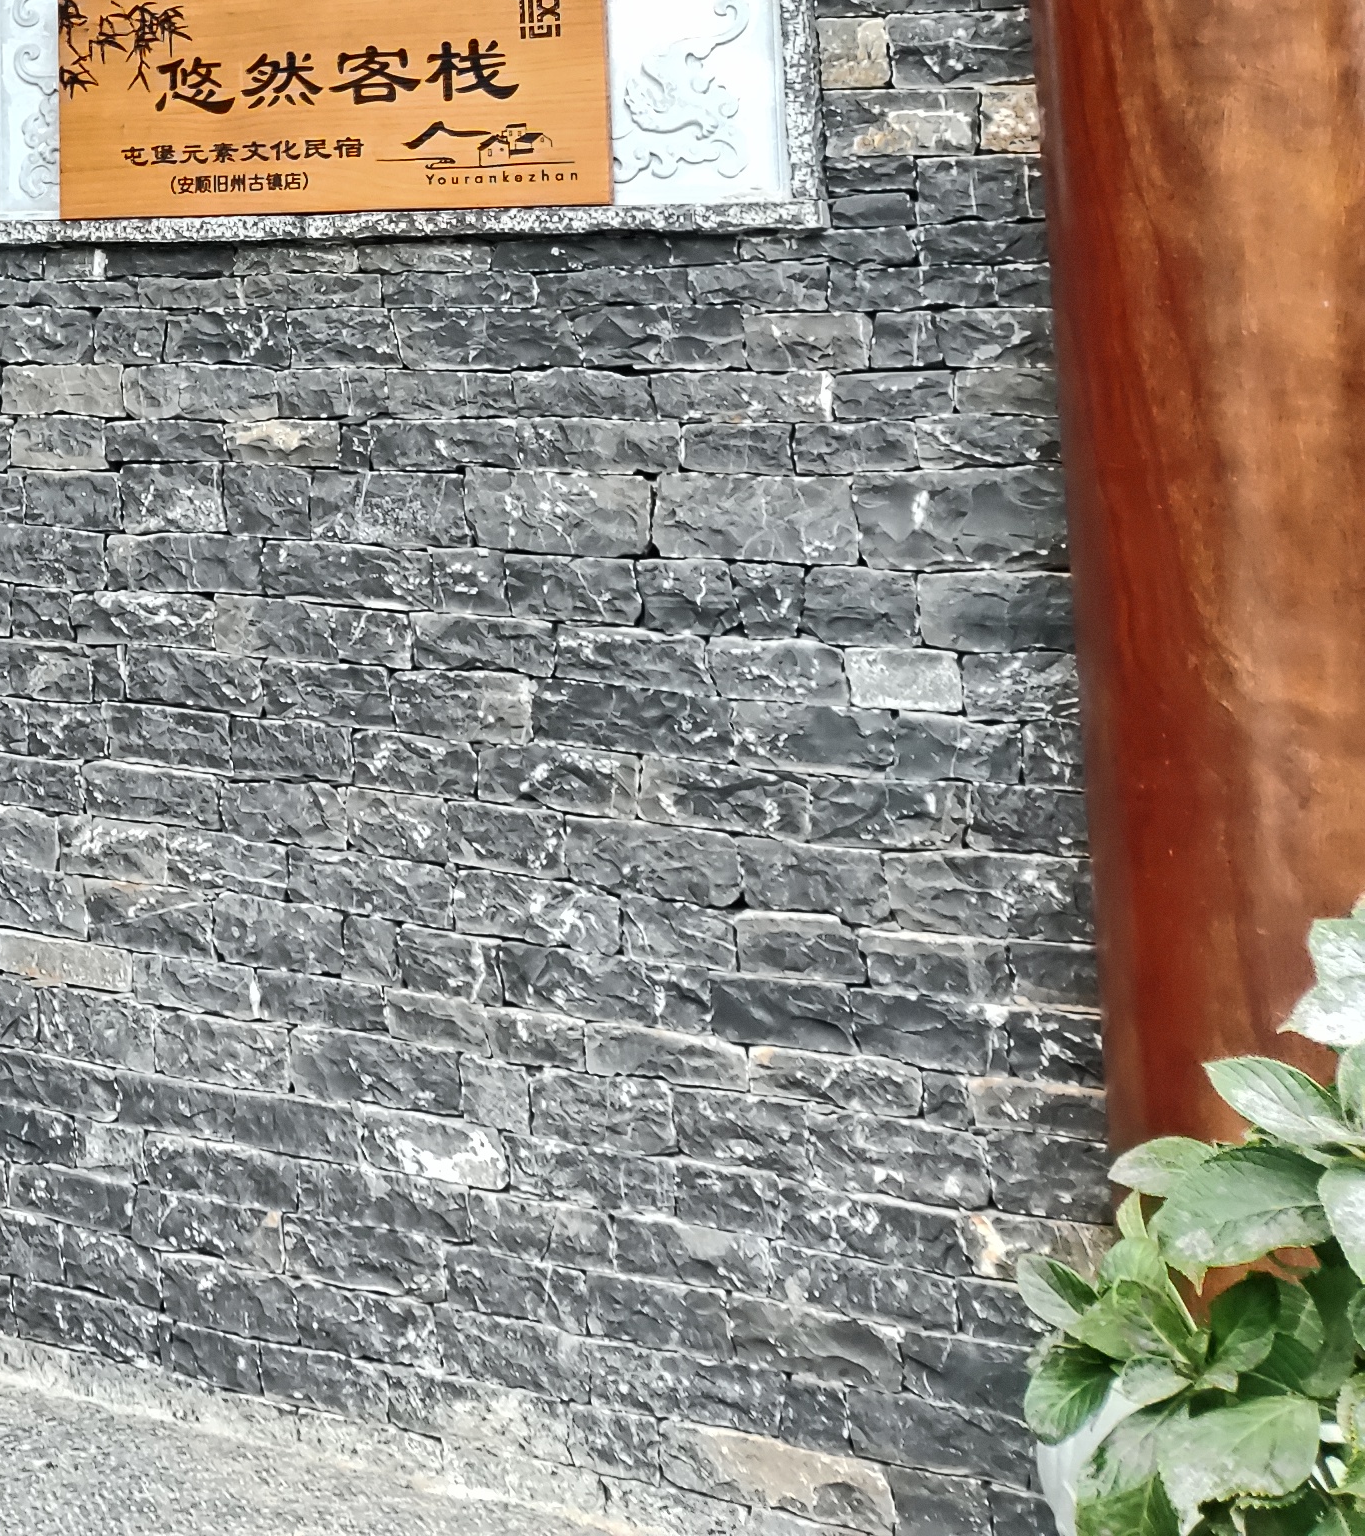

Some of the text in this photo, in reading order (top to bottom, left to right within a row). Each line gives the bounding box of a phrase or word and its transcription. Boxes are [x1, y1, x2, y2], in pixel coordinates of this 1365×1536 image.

[155, 38, 520, 115] 悠然客栈
[121, 136, 365, 167] 屯堡元素文化民宿
[424, 170, 579, 186] Yourankezhan
